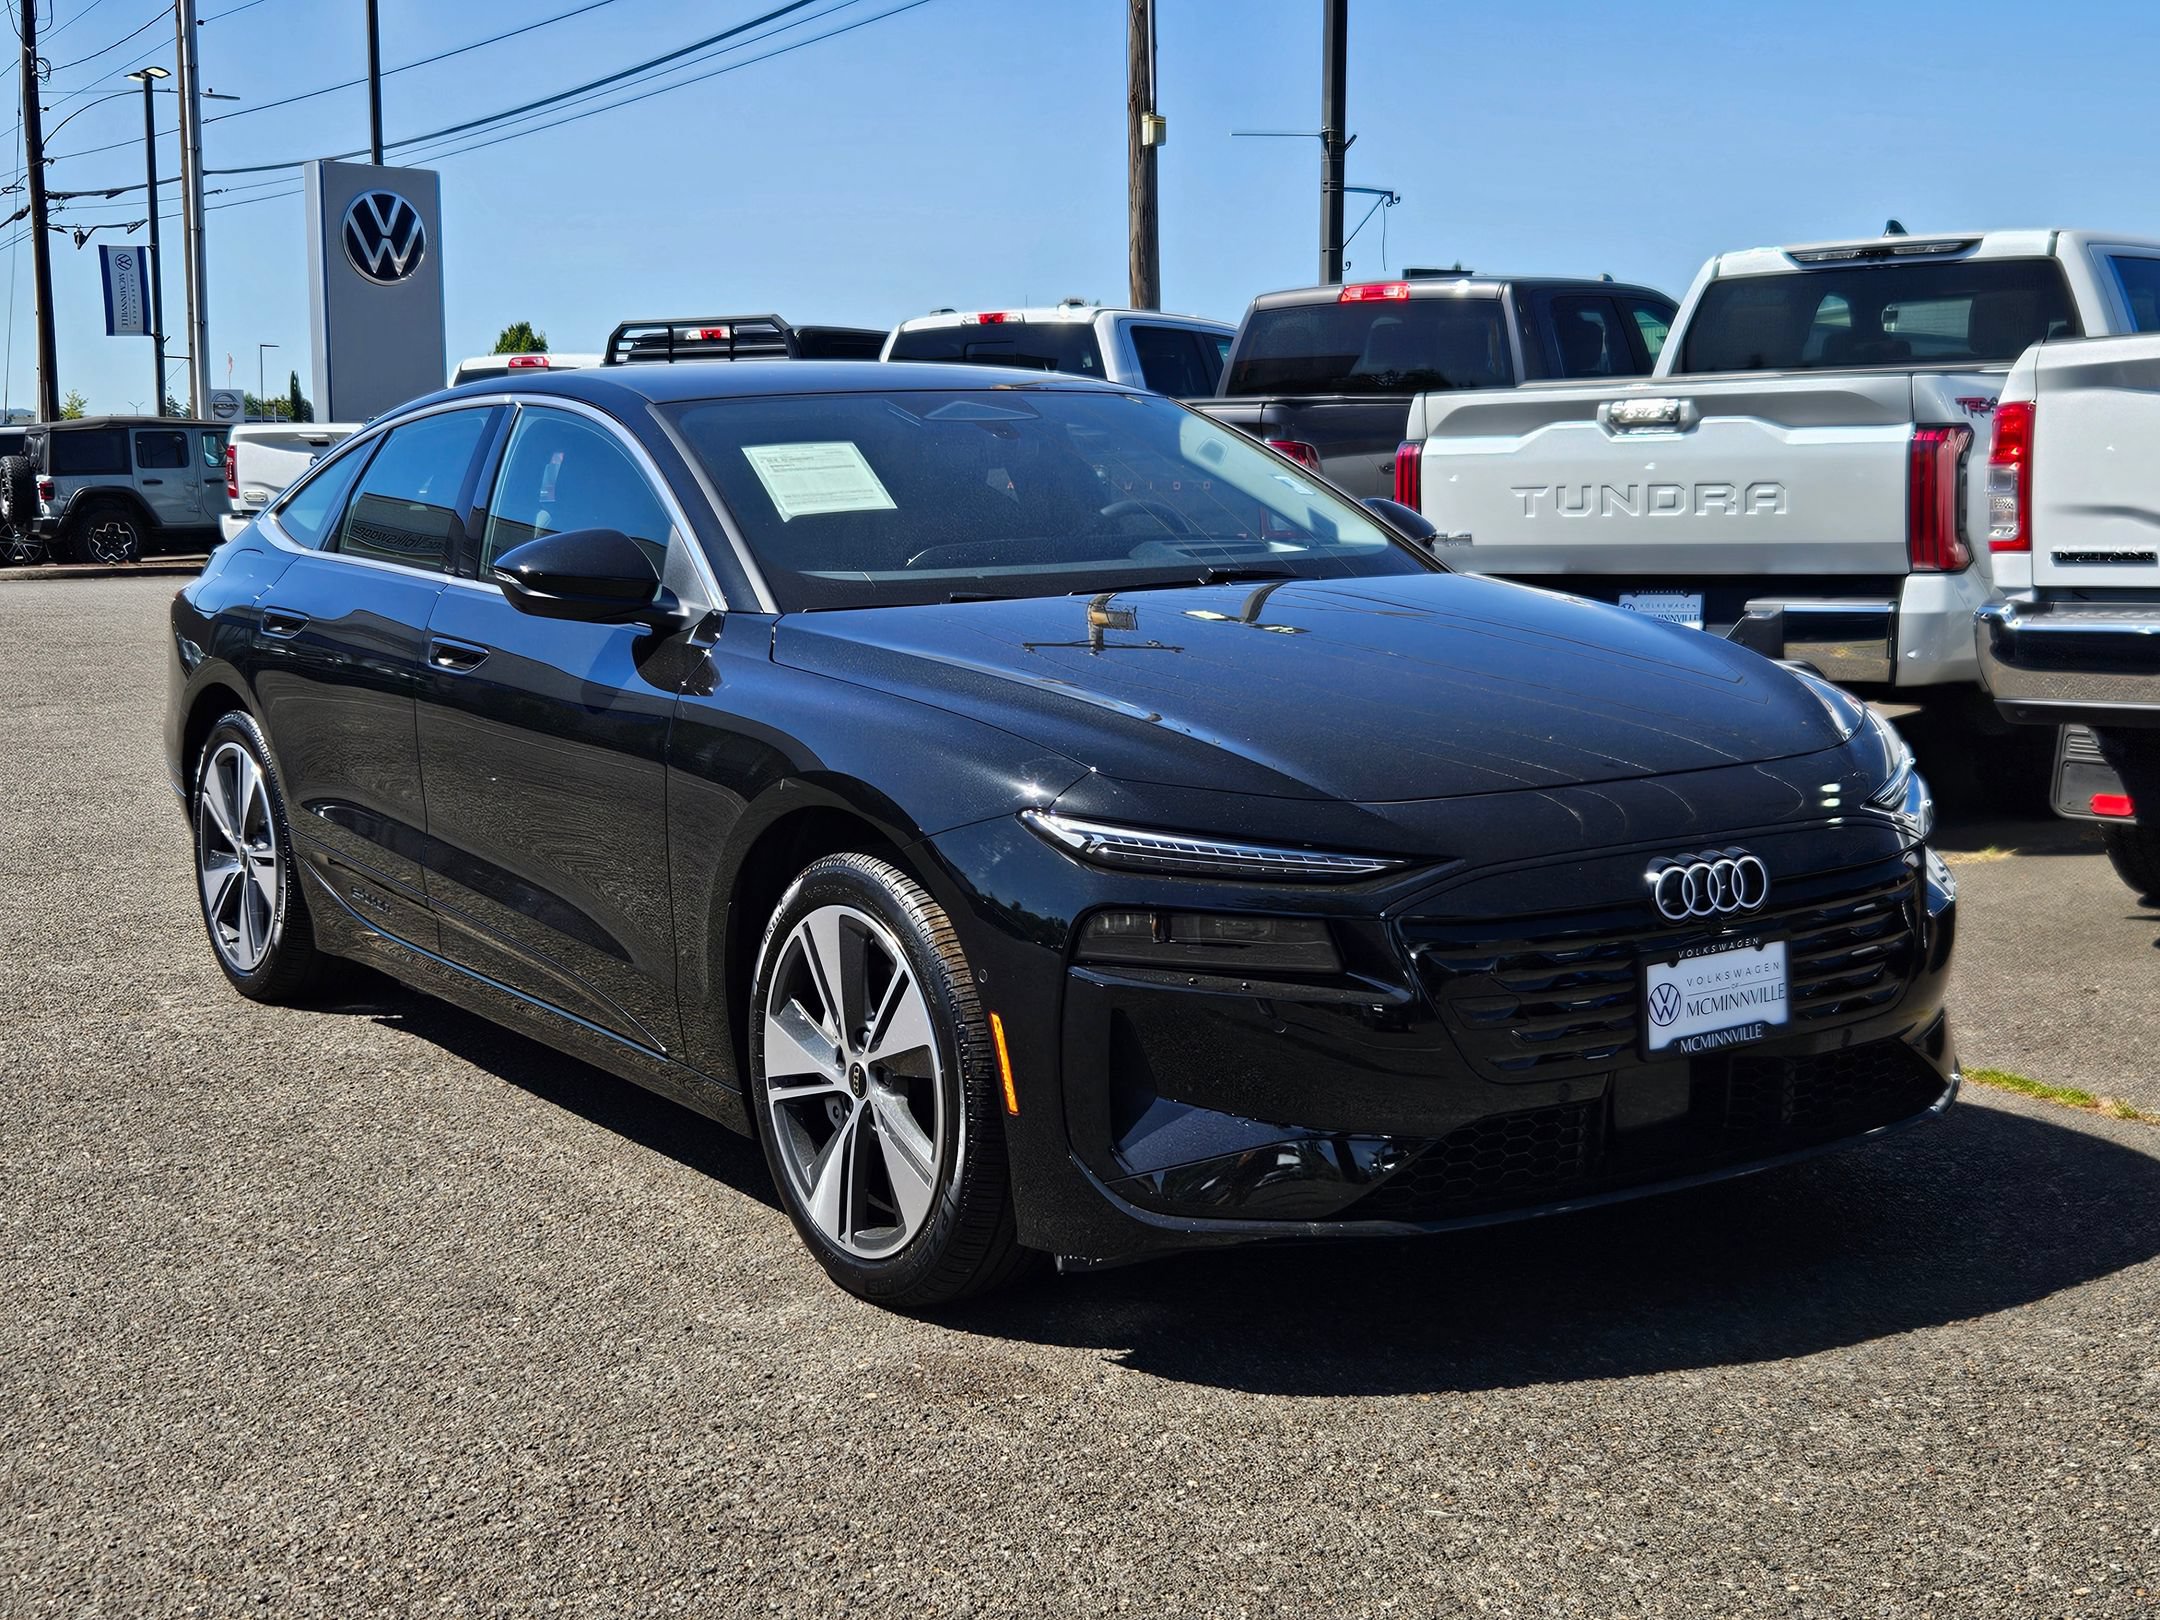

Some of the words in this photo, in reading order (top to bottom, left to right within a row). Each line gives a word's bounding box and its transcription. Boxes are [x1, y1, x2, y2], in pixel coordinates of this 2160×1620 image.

[1510, 482, 1788, 518] TUNDRA
[1678, 936, 1760, 959] VOLKSWAGEN
[1686, 961, 1781, 988] VOLKSWAGEN
[1686, 982, 1786, 1019] MCMINNVILLE
[1679, 1023, 1763, 1055] MCMINNVILLE
